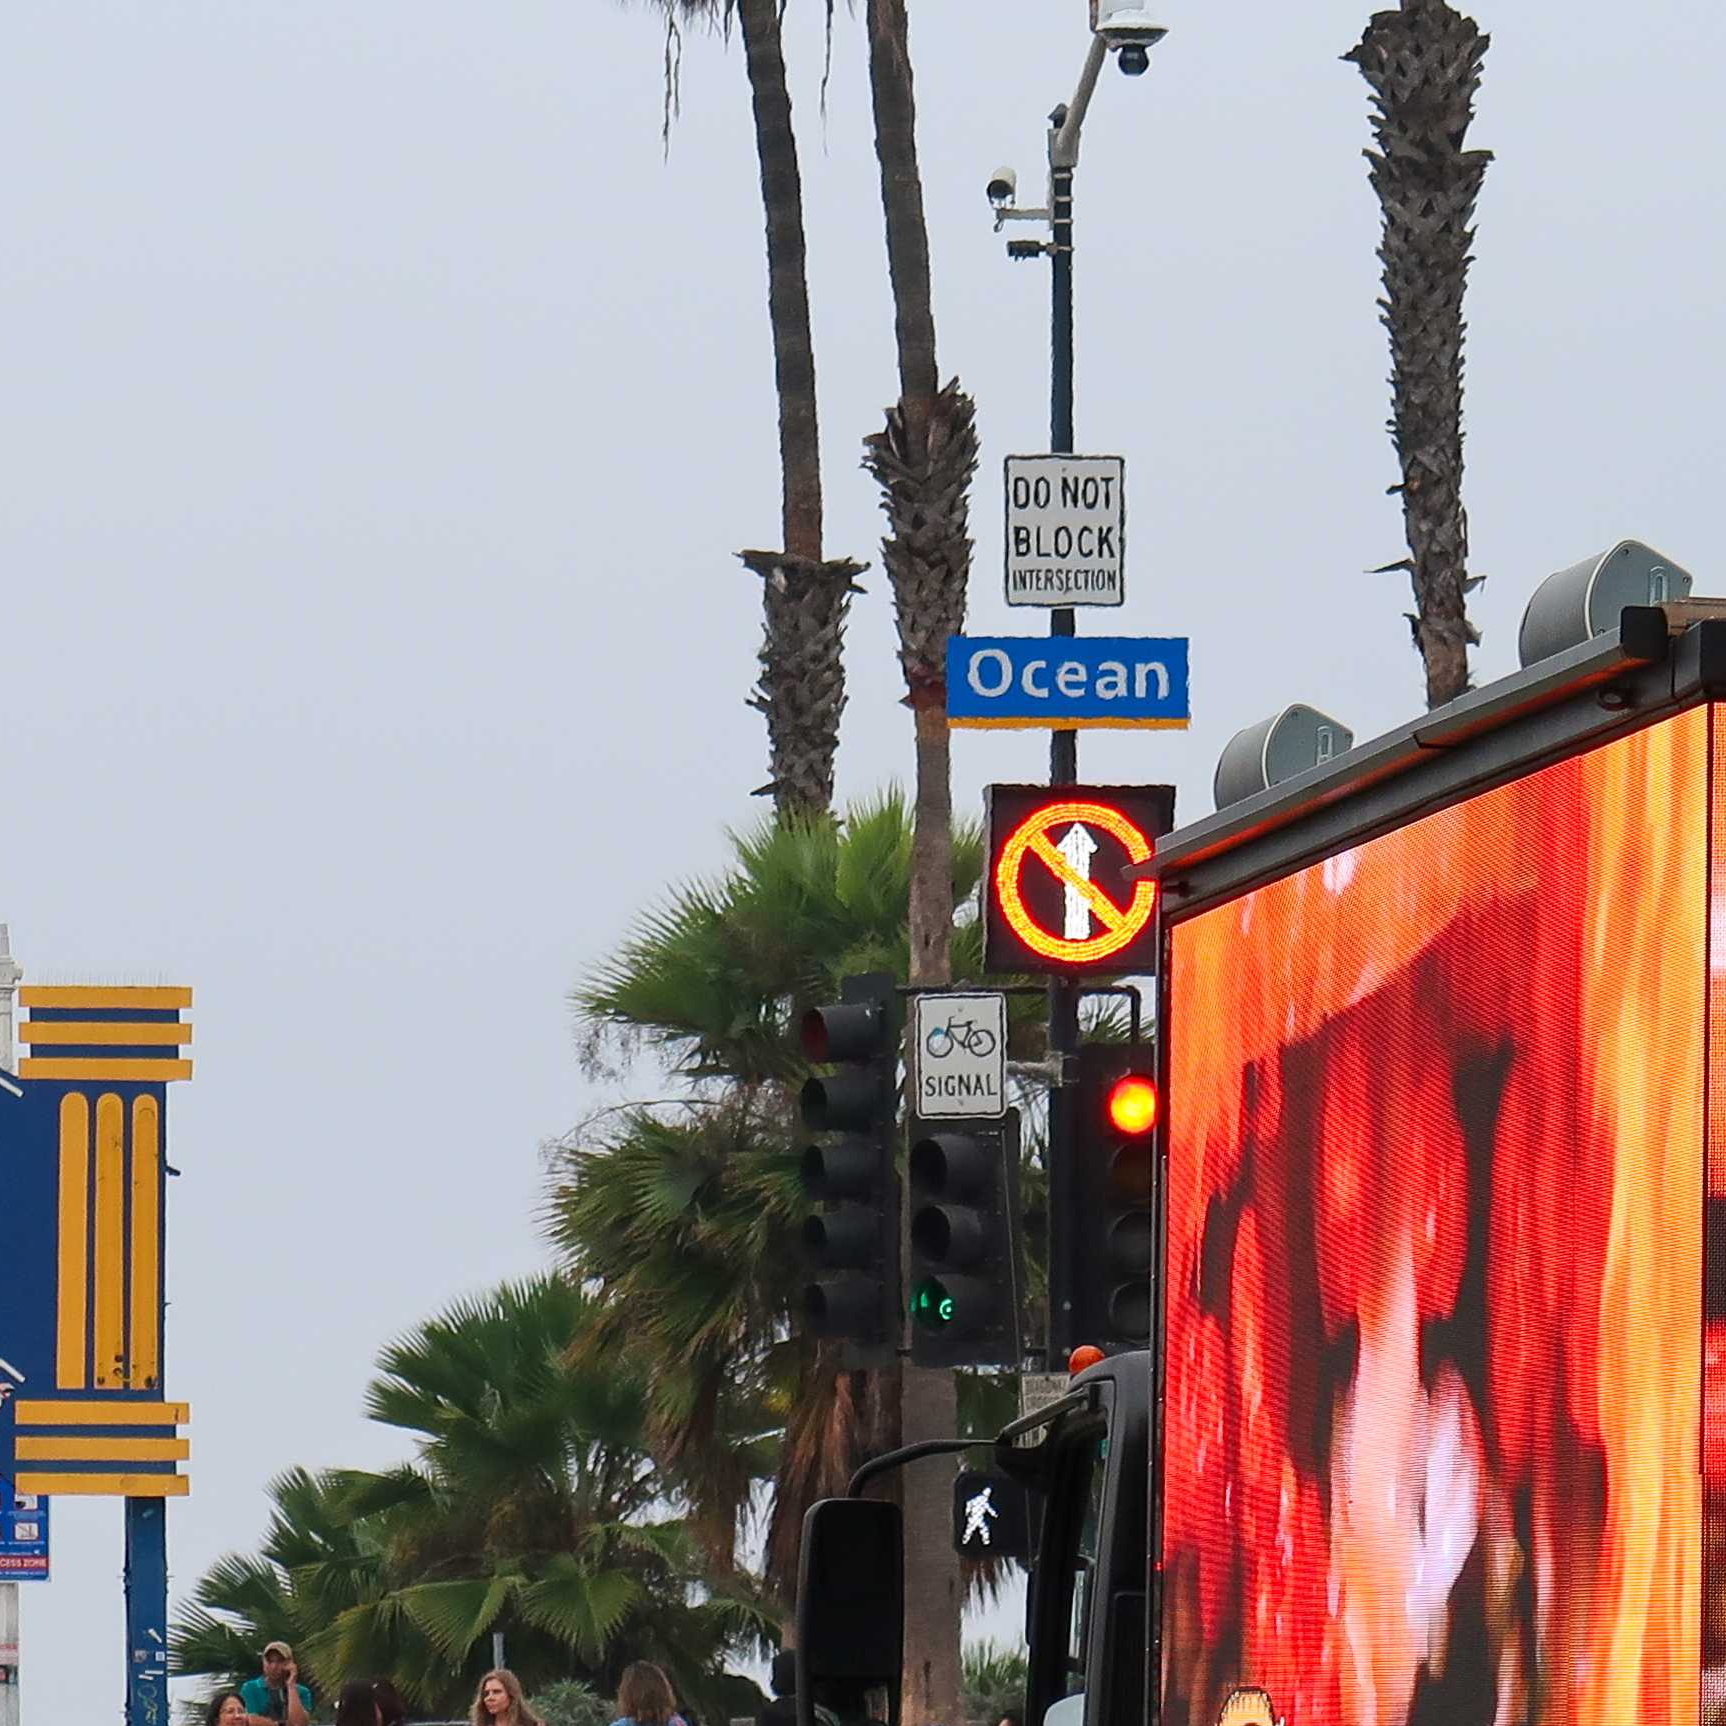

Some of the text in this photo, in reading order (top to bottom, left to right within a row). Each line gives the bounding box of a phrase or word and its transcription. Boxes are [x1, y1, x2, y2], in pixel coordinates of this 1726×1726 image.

[1013, 475, 1115, 511] DO NOT
[1014, 525, 1116, 559] BLOCK
[1012, 568, 1117, 593] INTERSECTION
[967, 648, 1171, 700] Ocean
[924, 1073, 998, 1099] SIGNAL
